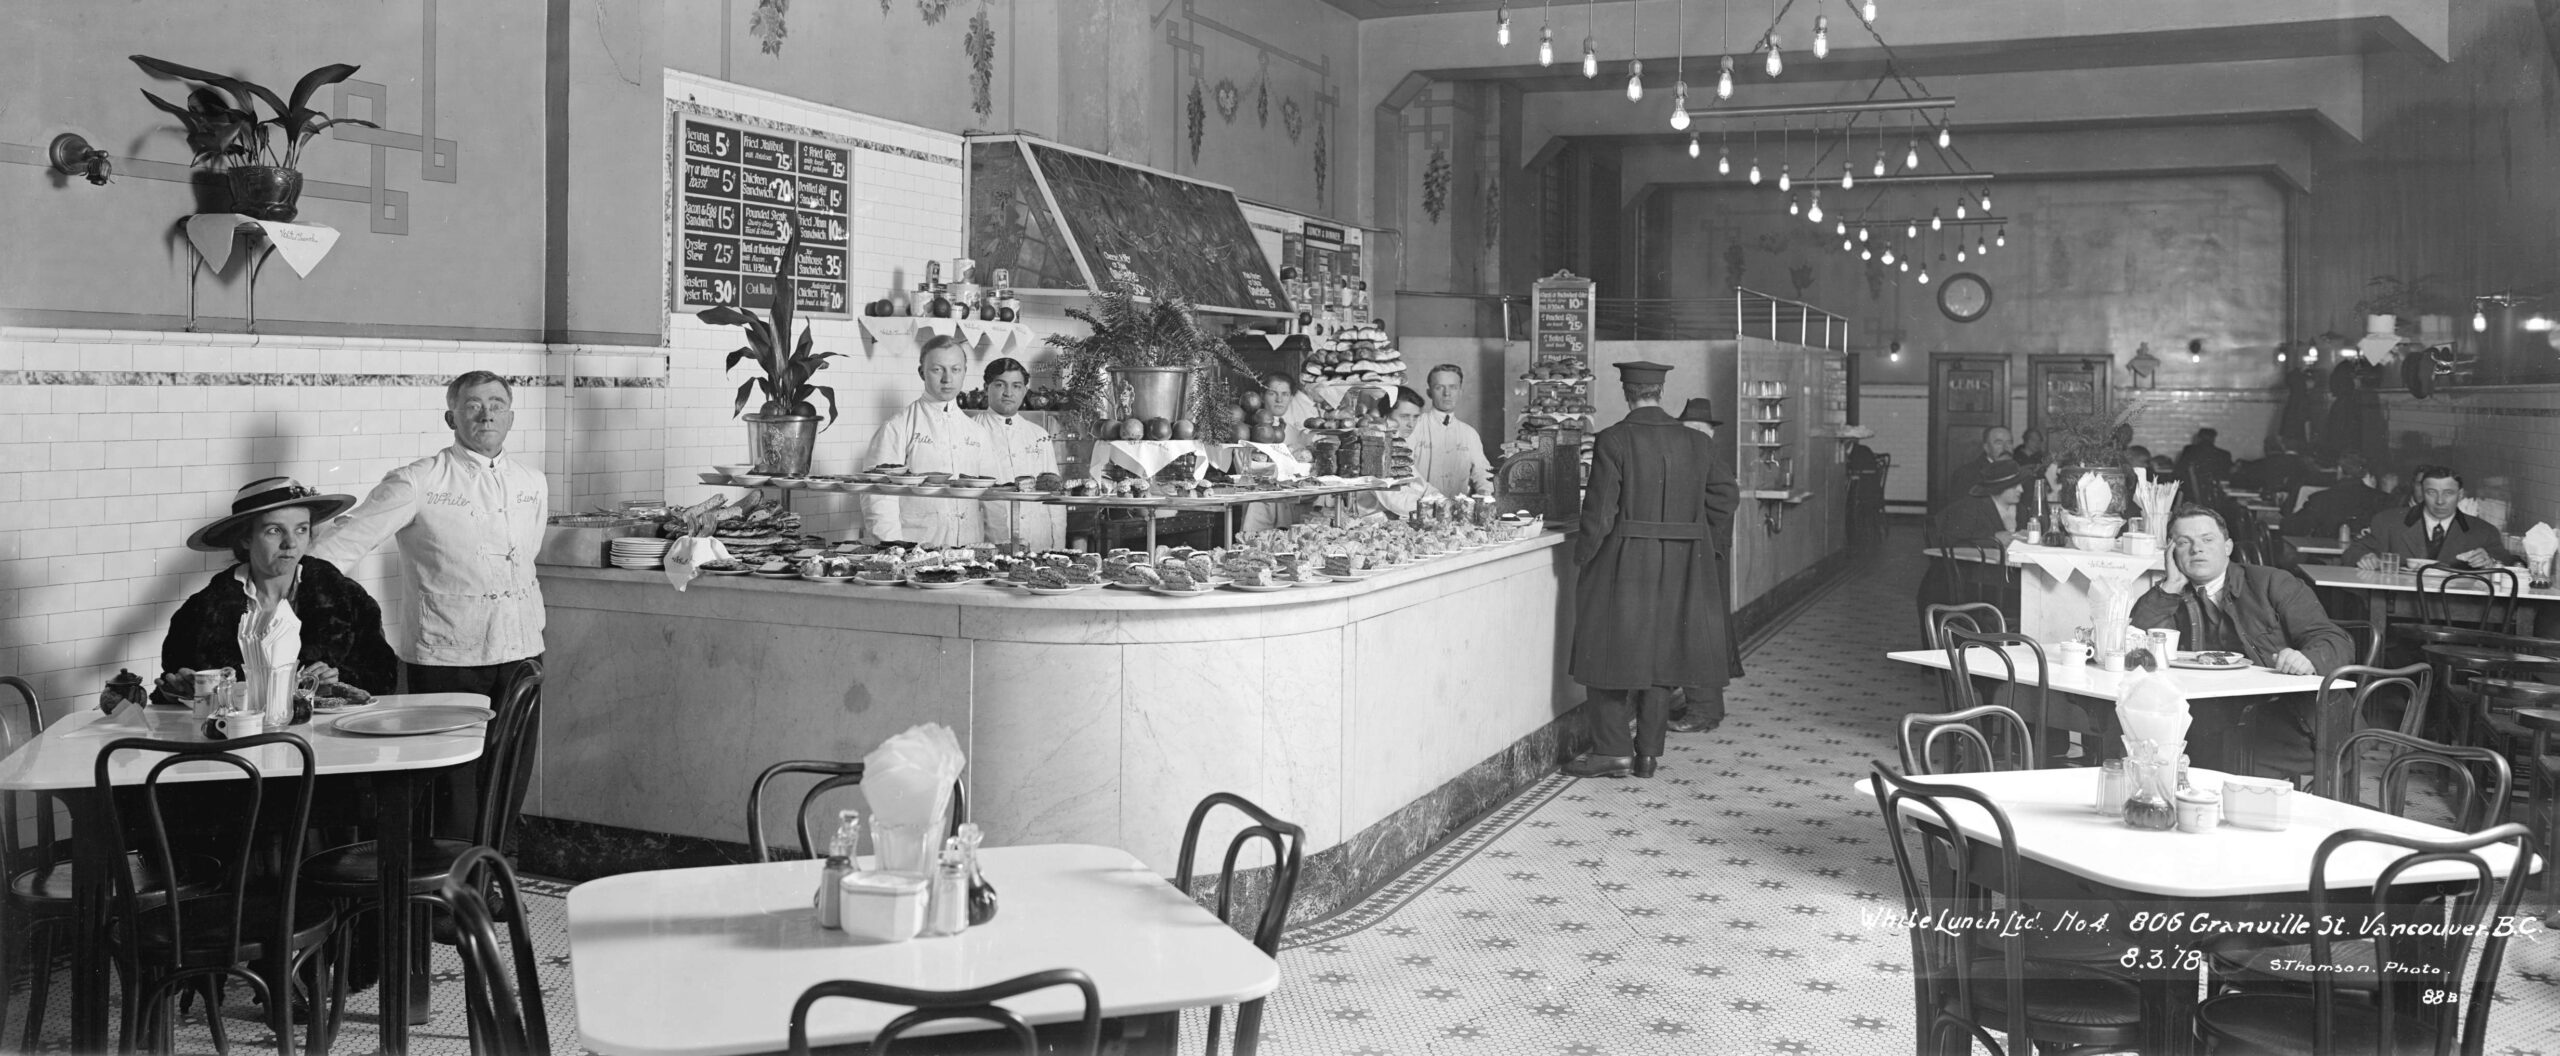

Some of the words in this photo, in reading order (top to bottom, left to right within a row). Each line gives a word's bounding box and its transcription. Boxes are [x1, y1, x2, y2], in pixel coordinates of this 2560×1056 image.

[715, 131, 730, 157] 5¢
[775, 152, 793, 171] 25¢
[830, 161, 845, 178] 25¢
[722, 169, 736, 193] 5¢
[718, 205, 735, 230] 15¢
[685, 238, 708, 252] Oyster
[686, 249, 703, 262] Stew
[713, 243, 734, 264] 25¢
[826, 254, 842, 276] 35¢
[684, 288, 701, 302] yster
[714, 279, 736, 303] 30¢
[830, 292, 844, 309] 20¢
[426, 490, 470, 507] White
